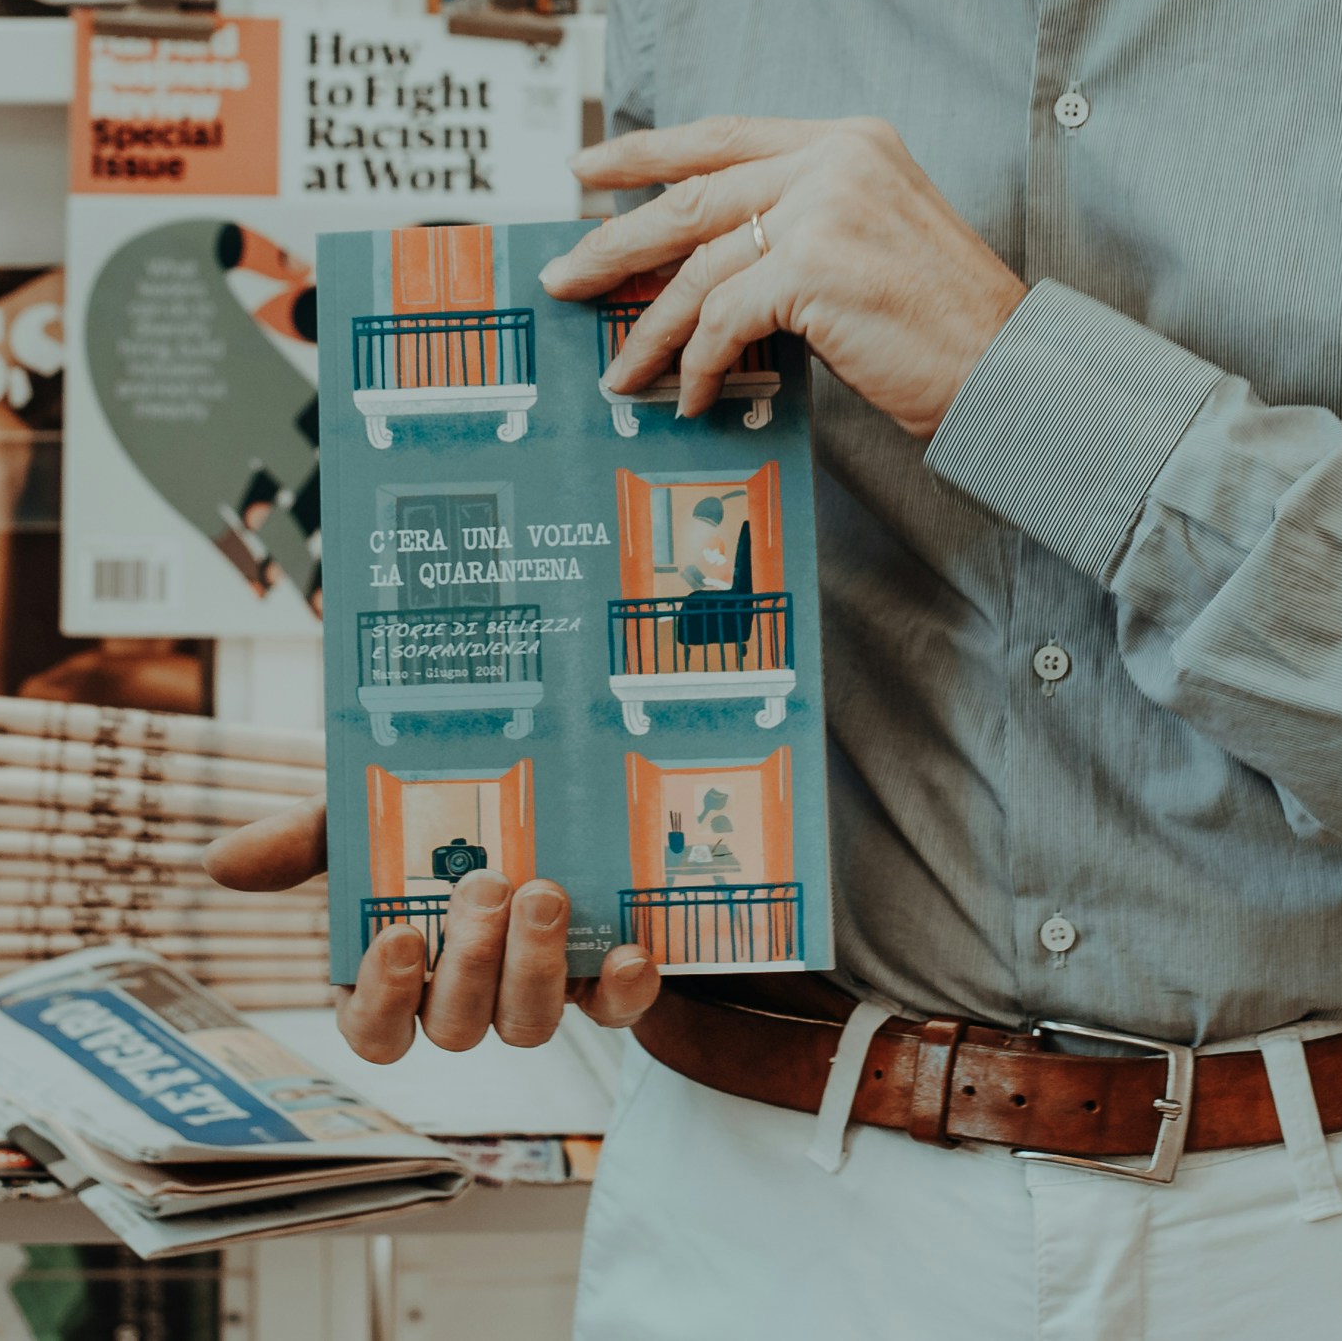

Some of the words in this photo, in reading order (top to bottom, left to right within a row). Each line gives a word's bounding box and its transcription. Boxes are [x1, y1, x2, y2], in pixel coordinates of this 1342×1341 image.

[307, 32, 416, 69] How
[307, 77, 354, 110] to
[364, 74, 492, 118] Fight
[90, 118, 225, 156] Special
[305, 115, 491, 152] Racism
[90, 156, 187, 181] Issue
[304, 160, 347, 192] at
[360, 158, 495, 193] Work
[369, 527, 449, 555] C'ERA
[462, 526, 513, 551] UNA
[526, 522, 612, 548] VOLTA
[369, 563, 405, 588] LA
[418, 556, 584, 590] QUARANTENA
[371, 621, 445, 639] STORIE
[450, 621, 479, 637] DI
[485, 617, 582, 636] BELLEZZA
[371, 645, 387, 660] E
[372, 668, 409, 680] Marzo
[425, 665, 469, 681] Giugno
[474, 664, 506, 678] 2020
[597, 923, 613, 935] di
